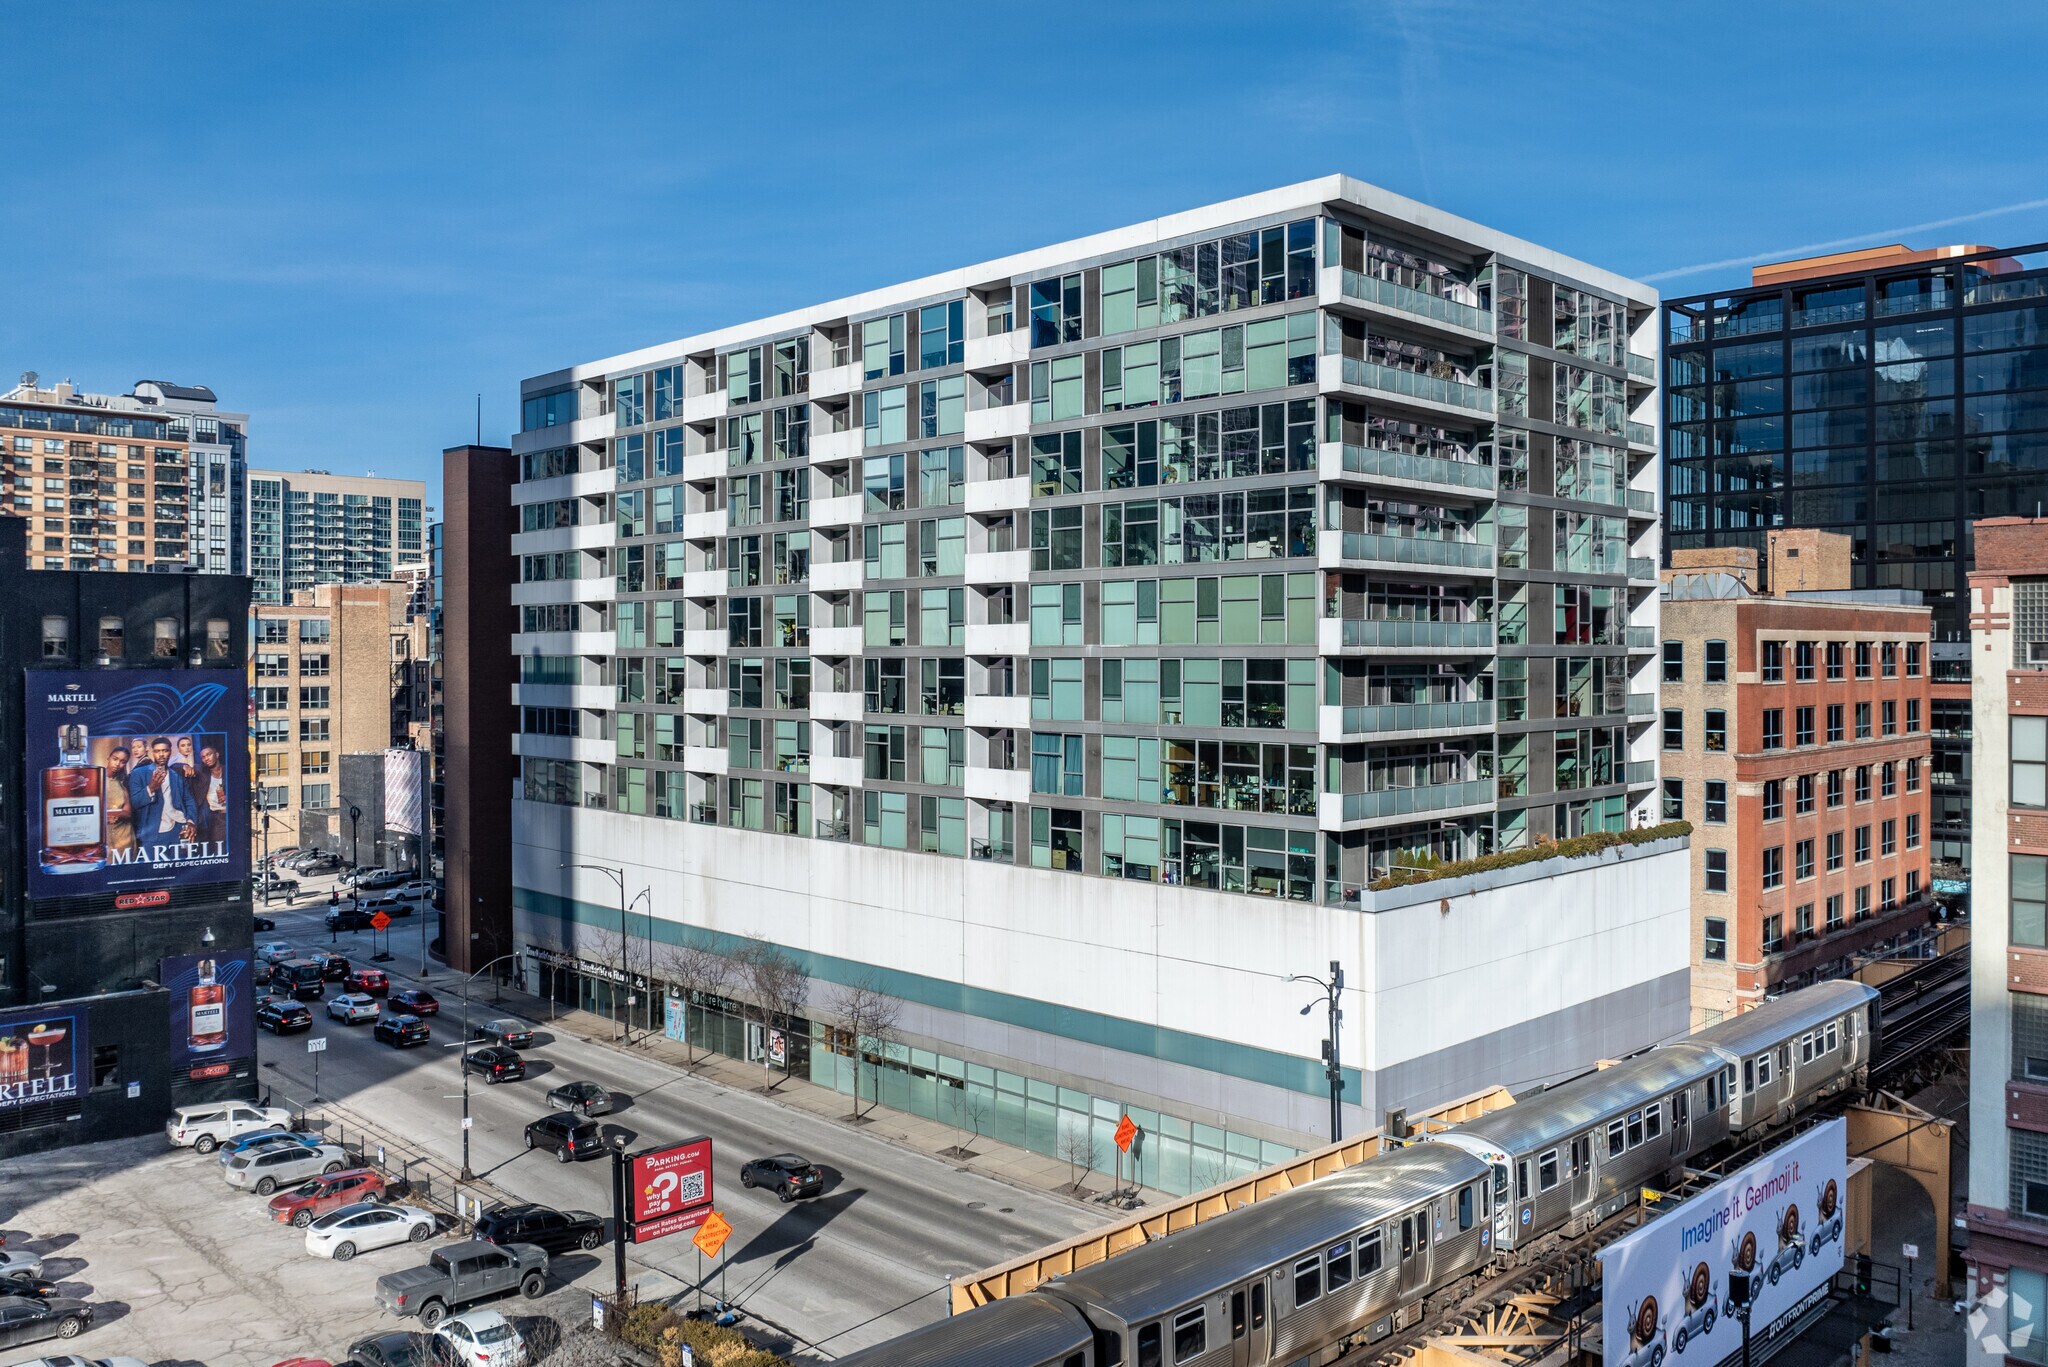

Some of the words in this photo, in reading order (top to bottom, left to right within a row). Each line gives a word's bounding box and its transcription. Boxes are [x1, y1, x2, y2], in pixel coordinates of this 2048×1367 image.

[48, 693, 97, 702] MARTELL
[54, 806, 93, 815] MARTELL
[111, 840, 230, 866] MARTELL
[175, 858, 229, 868] EXPECTATIONS
[146, 895, 166, 903] STAR
[20, 1090, 77, 1104] EXPECTATIONS
[649, 1200, 661, 1209] pay
[1681, 1207, 1730, 1252] Imagine
[1733, 1196, 1743, 1220] it.
[1745, 1164, 1790, 1211] Genmoji
[1792, 1161, 1801, 1183] it.
[643, 1207, 661, 1216] more
[639, 1223, 660, 1233] Lowest
[661, 1218, 677, 1227] Rates
[678, 1208, 710, 1222] Guaranteed
[661, 1220, 696, 1233] Parking.com
[706, 1222, 718, 1230] ROAD
